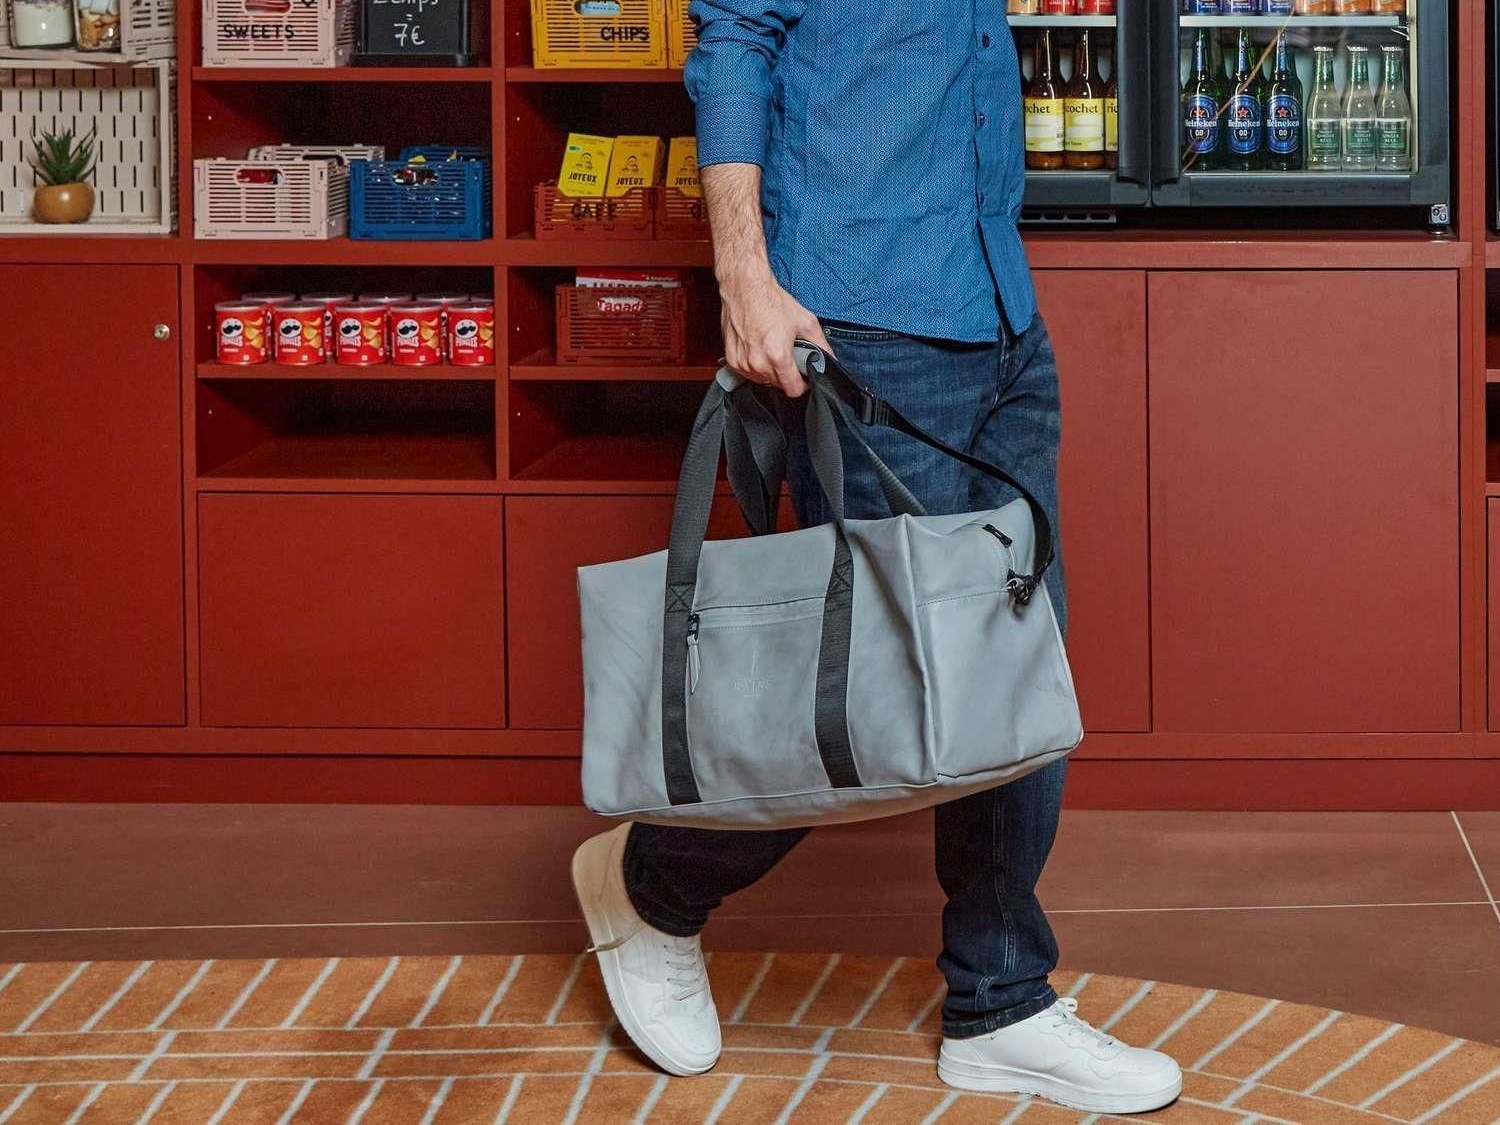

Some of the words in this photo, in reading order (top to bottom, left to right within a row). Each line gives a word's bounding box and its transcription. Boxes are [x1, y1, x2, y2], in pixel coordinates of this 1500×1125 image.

[222, 24, 295, 40] SWEETS
[394, 23, 425, 47] 7€
[600, 26, 650, 42] CHIPS
[1185, 119, 1217, 127] Heineken
[1228, 119, 1261, 128] Heineken
[1267, 119, 1300, 127] Heineken
[568, 171, 599, 183] JOYEUX
[616, 177, 646, 186] JOYEUX
[674, 177, 701, 186] JOYEU
